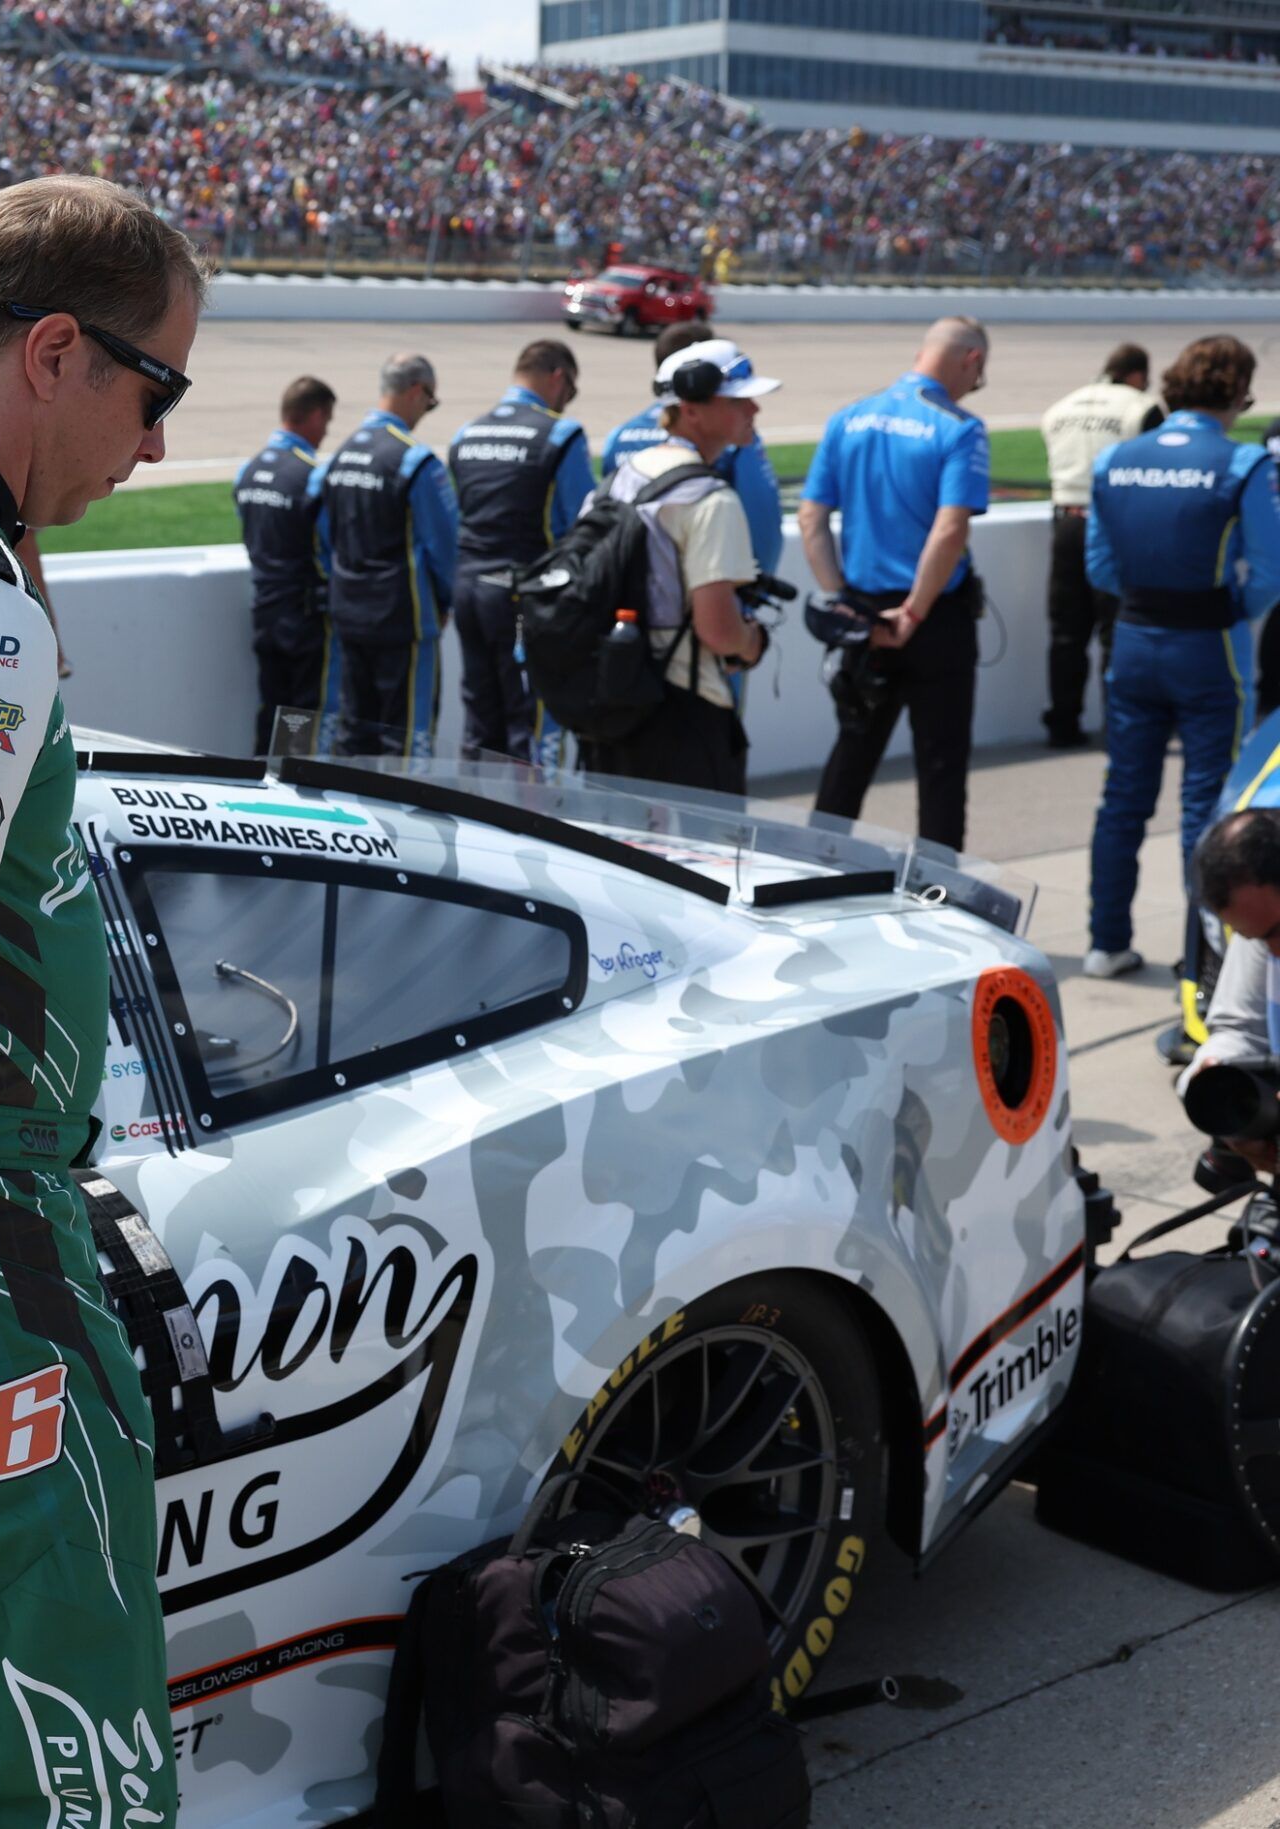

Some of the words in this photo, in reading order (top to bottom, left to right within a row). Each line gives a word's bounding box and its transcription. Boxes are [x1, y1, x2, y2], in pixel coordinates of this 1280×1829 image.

[1108, 467, 1216, 490] WABASH
[111, 787, 207, 811] BUILD
[128, 814, 398, 859] SUBMARINES.COM
[563, 1311, 686, 1466] EAGLE
[969, 1307, 1078, 1427] Trimble
[166, 1660, 259, 1703] SELOWSKI
[278, 1633, 345, 1665] RACING
